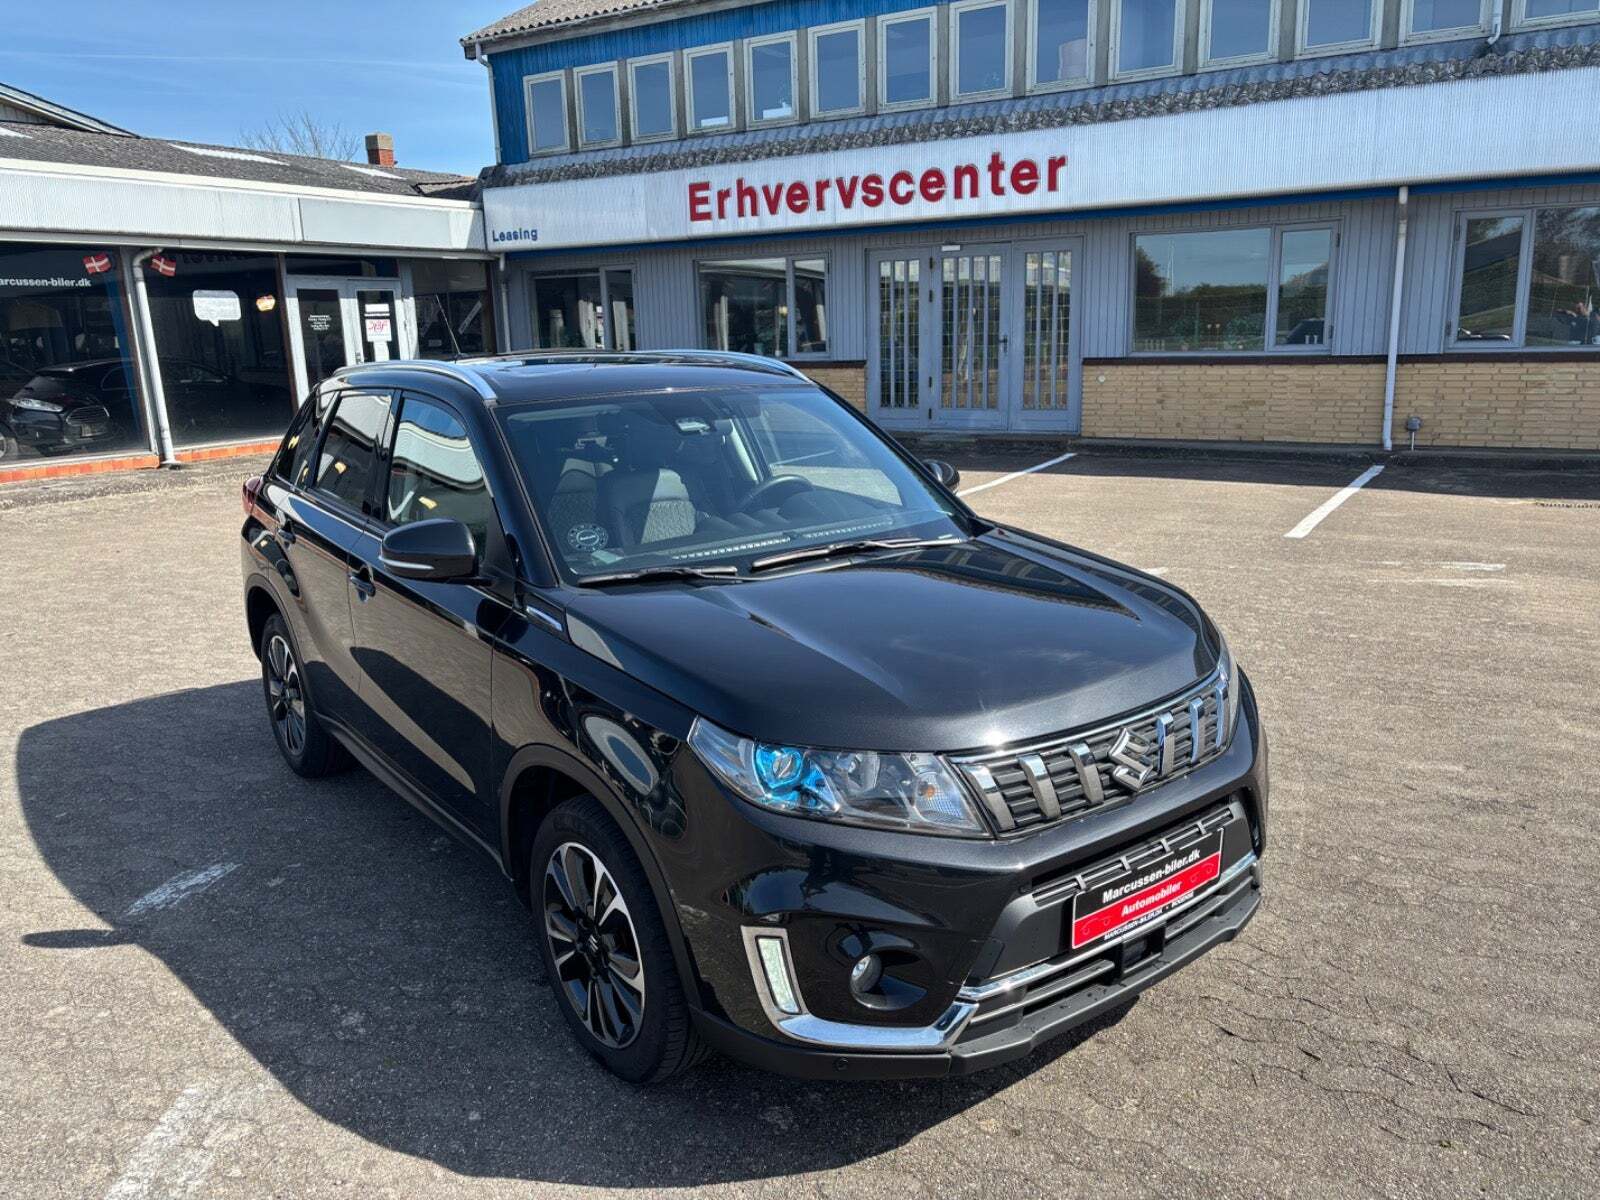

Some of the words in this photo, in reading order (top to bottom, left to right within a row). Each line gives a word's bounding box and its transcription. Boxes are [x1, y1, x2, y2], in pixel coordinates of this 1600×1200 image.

[688, 151, 1067, 222] Erhvervscenter
[491, 227, 538, 241] Leasing
[1102, 848, 1201, 904] Marcussen-biler.dk
[1121, 881, 1183, 917] Automobiler
